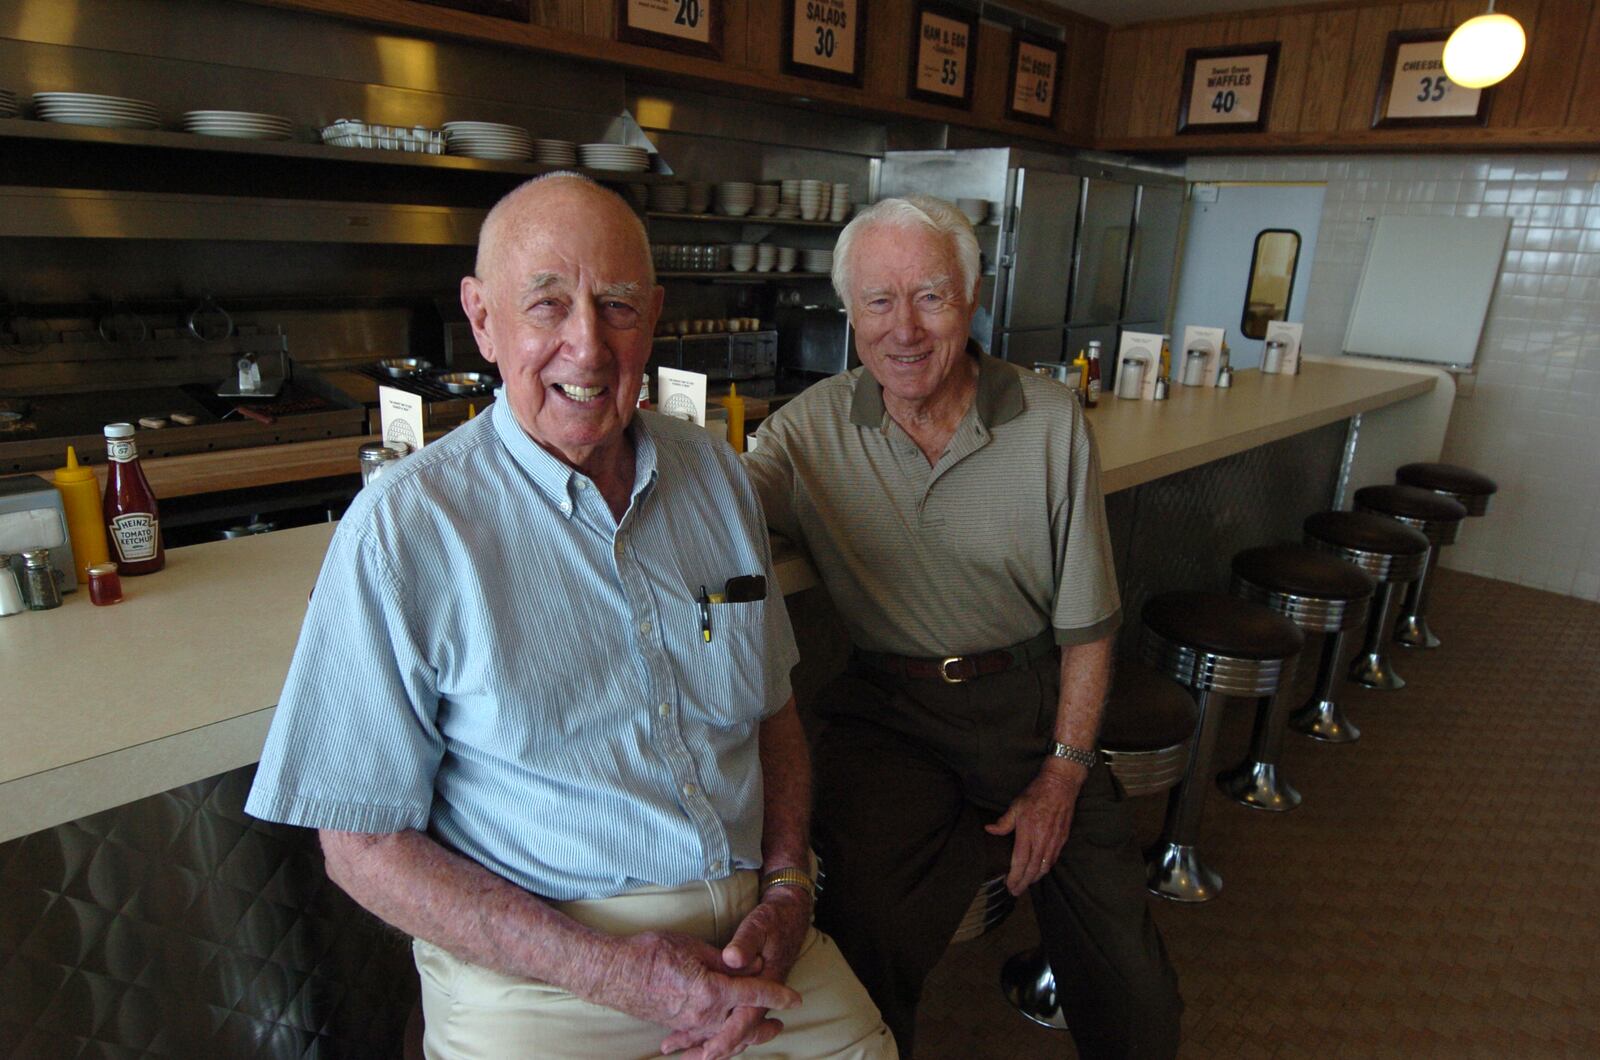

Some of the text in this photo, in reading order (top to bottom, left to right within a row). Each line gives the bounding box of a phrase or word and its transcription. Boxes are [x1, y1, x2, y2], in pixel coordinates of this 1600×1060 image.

[806, 2, 847, 29] SALADS
[941, 58, 957, 86] 55
[1207, 74, 1252, 88] WAFFLES
[121, 519, 148, 529] HEINZ
[120, 529, 152, 539] TOMATO
[120, 535, 153, 545] KETCHUP
